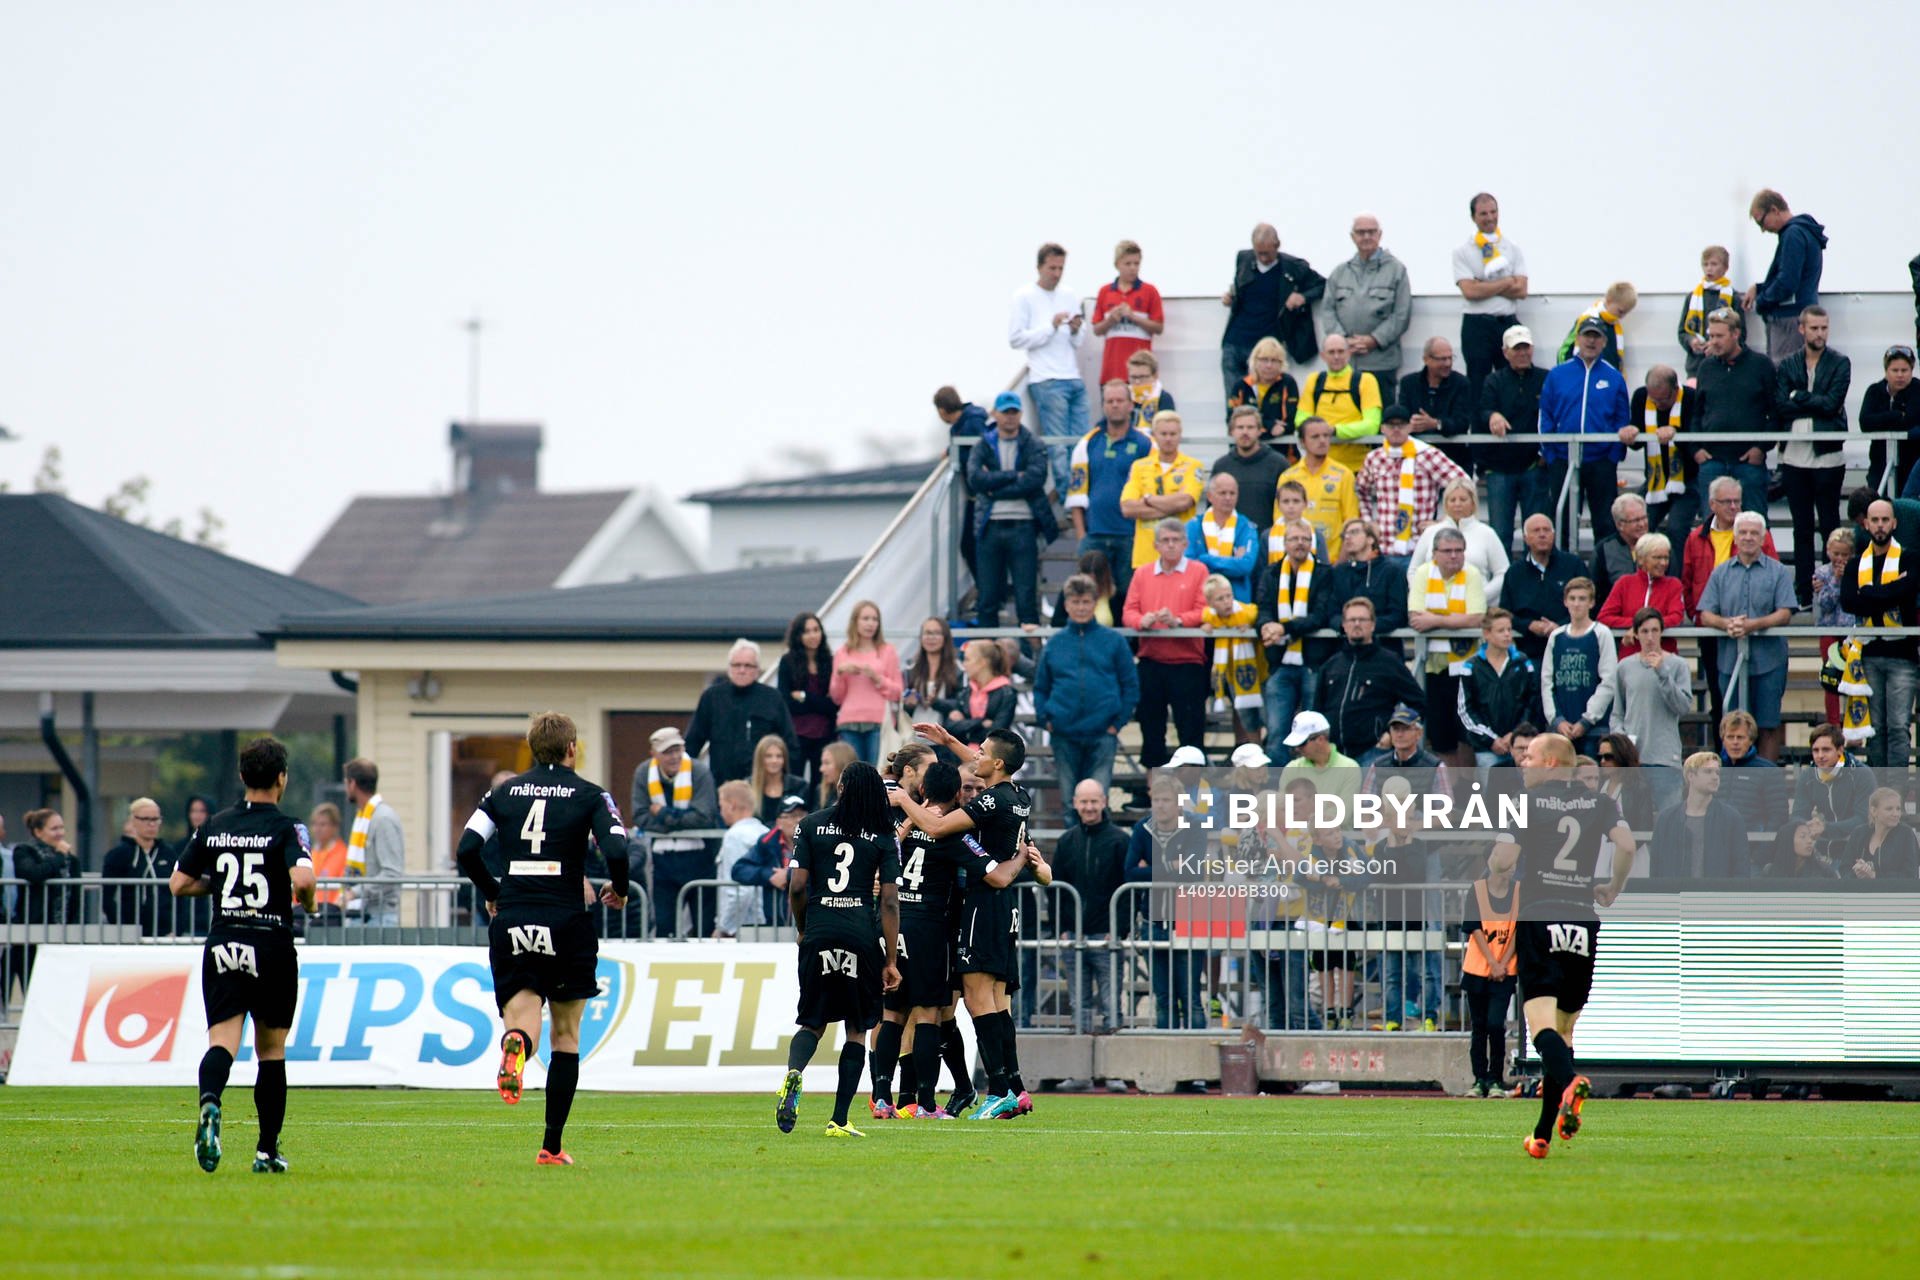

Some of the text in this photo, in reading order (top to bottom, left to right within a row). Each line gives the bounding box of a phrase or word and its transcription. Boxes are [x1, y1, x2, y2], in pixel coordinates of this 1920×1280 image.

[510, 783, 575, 798] mätcenter
[206, 833, 272, 848] mätcenter
[520, 799, 546, 854] 4
[1553, 815, 1581, 872] 2
[216, 852, 270, 909] 25
[827, 842, 855, 893] 3
[507, 924, 556, 956] NA
[1546, 923, 1590, 957] NA
[211, 941, 259, 978] NA
[818, 948, 859, 979] NA
